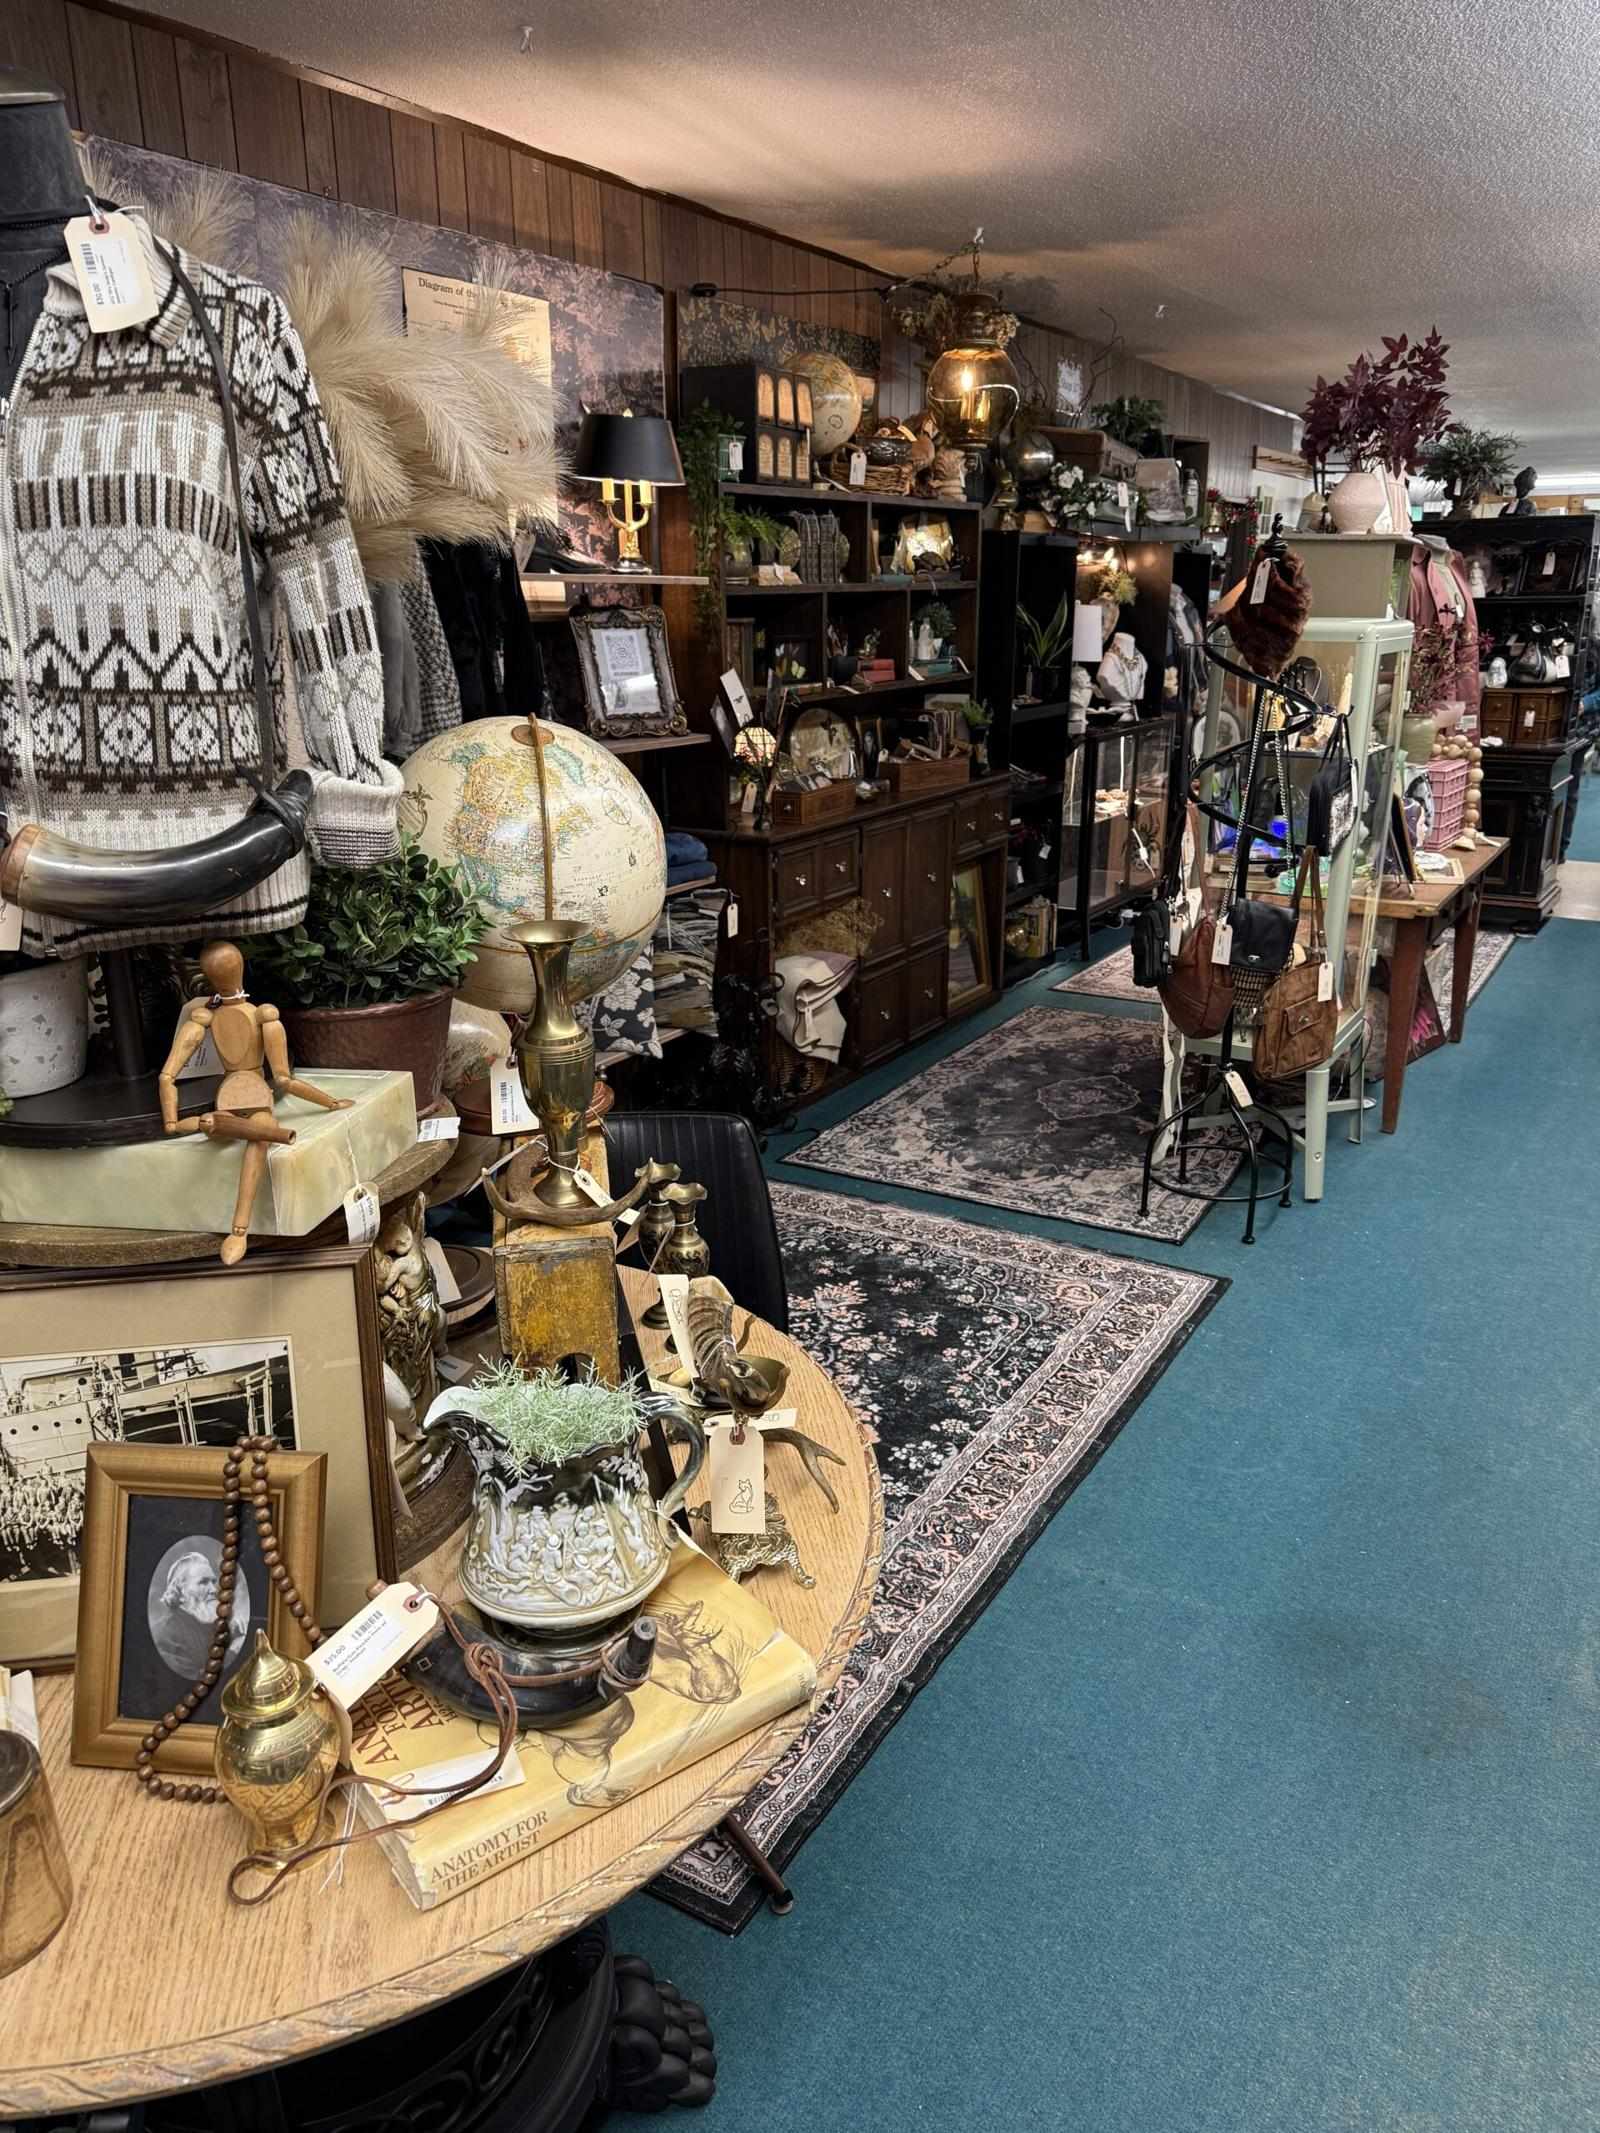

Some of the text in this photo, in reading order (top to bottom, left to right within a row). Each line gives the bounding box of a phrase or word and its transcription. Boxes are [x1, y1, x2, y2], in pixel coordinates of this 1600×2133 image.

[418, 276, 453, 294] Diagram
[455, 287, 464, 297] of
[349, 1702, 399, 1765] ANAT
[369, 1700, 407, 1736] FOR
[431, 1810, 549, 1884] ANATOMY FOR
[442, 1829, 542, 1890] THE ARTIST
